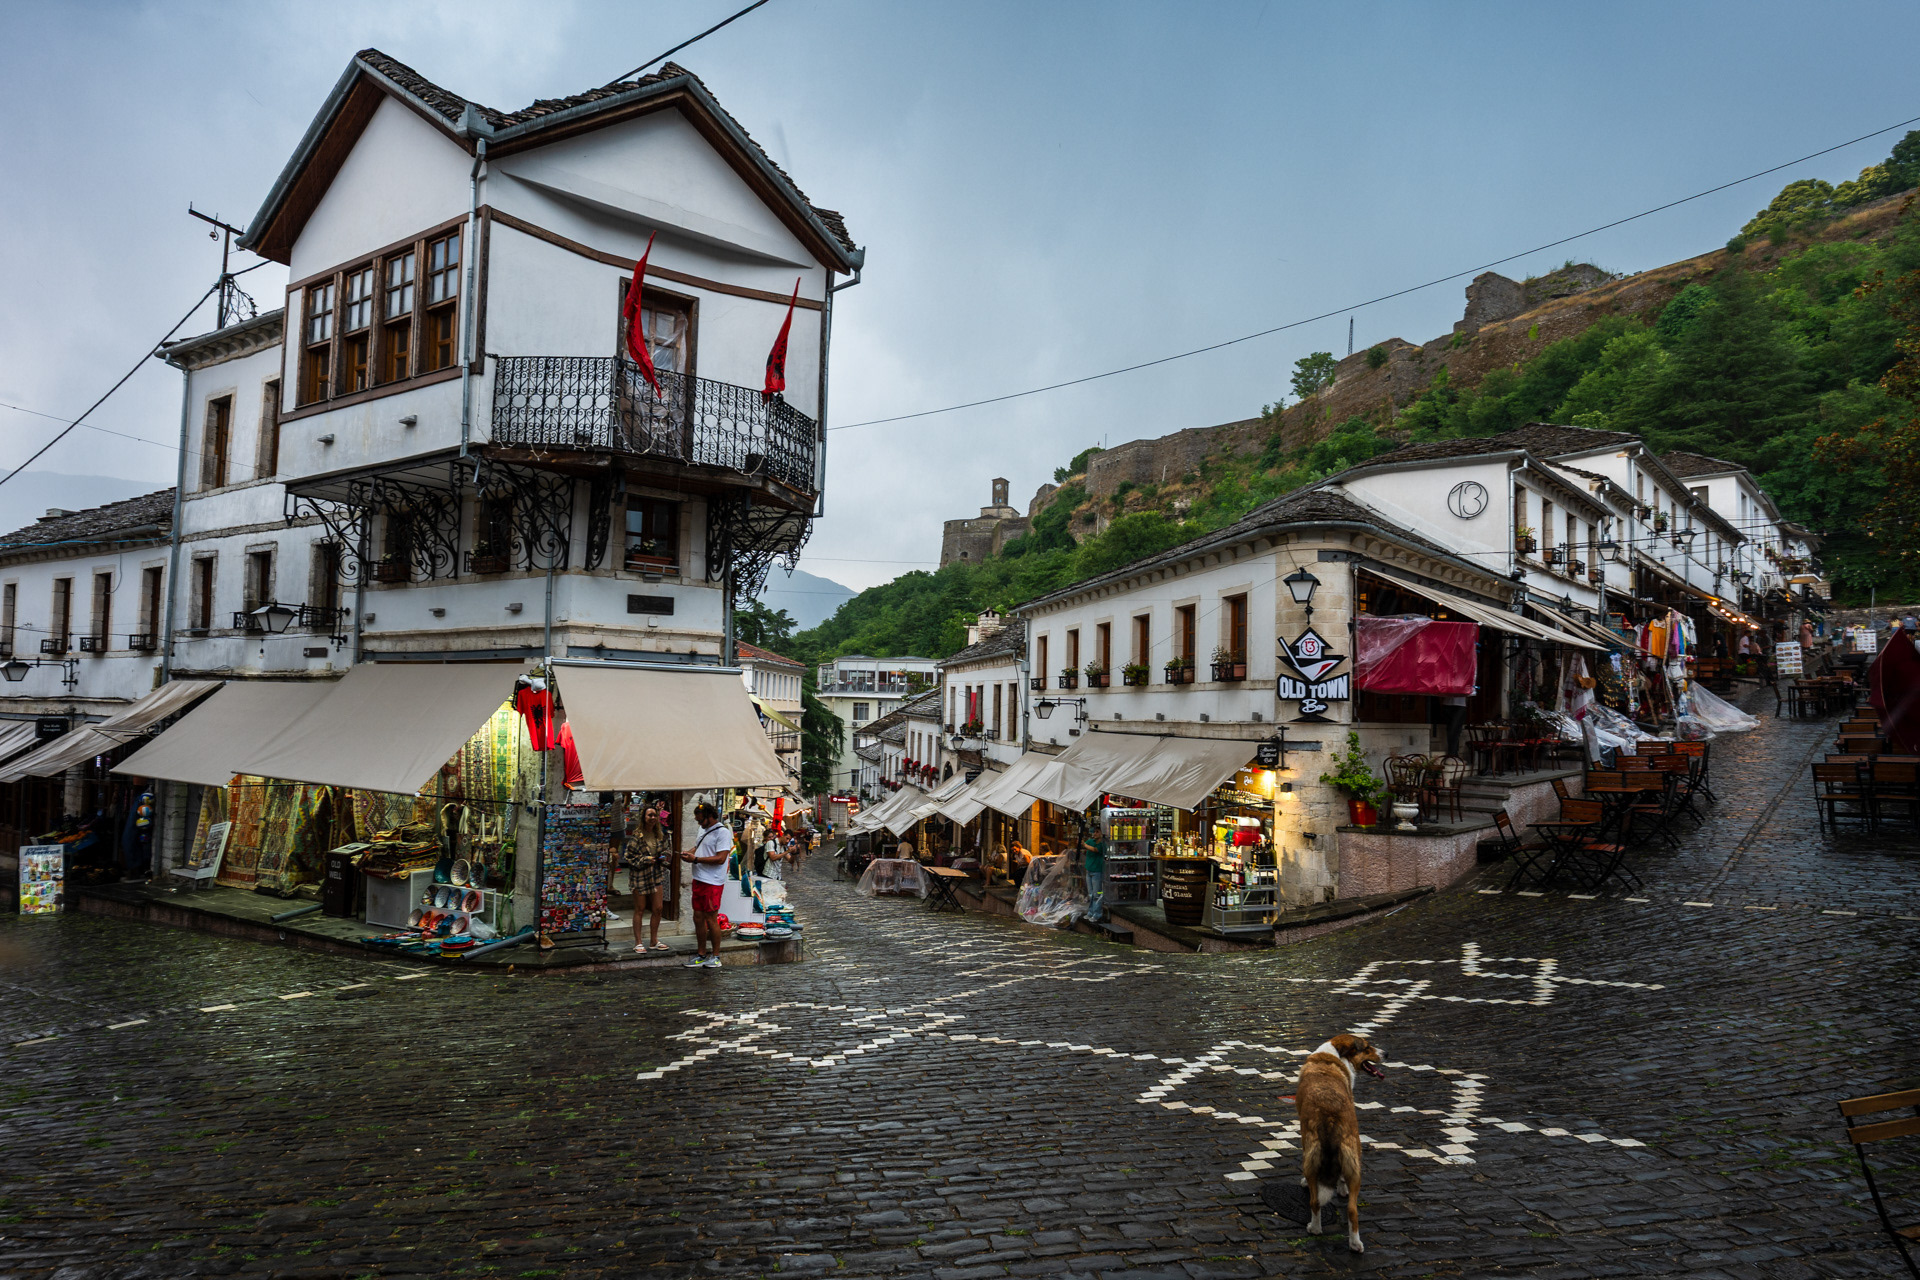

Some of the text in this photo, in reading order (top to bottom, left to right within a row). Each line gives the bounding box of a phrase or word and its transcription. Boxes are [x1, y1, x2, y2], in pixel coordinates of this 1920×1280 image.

[1451, 483, 1483, 518] 13
[1304, 641, 1316, 653] 13
[1279, 673, 1348, 699] OLD TOWN
[1301, 698, 1327, 713] Bar
[561, 808, 591, 816] MAGNETS
[330, 860, 342, 869] OLD
[328, 870, 342, 880] WELL
